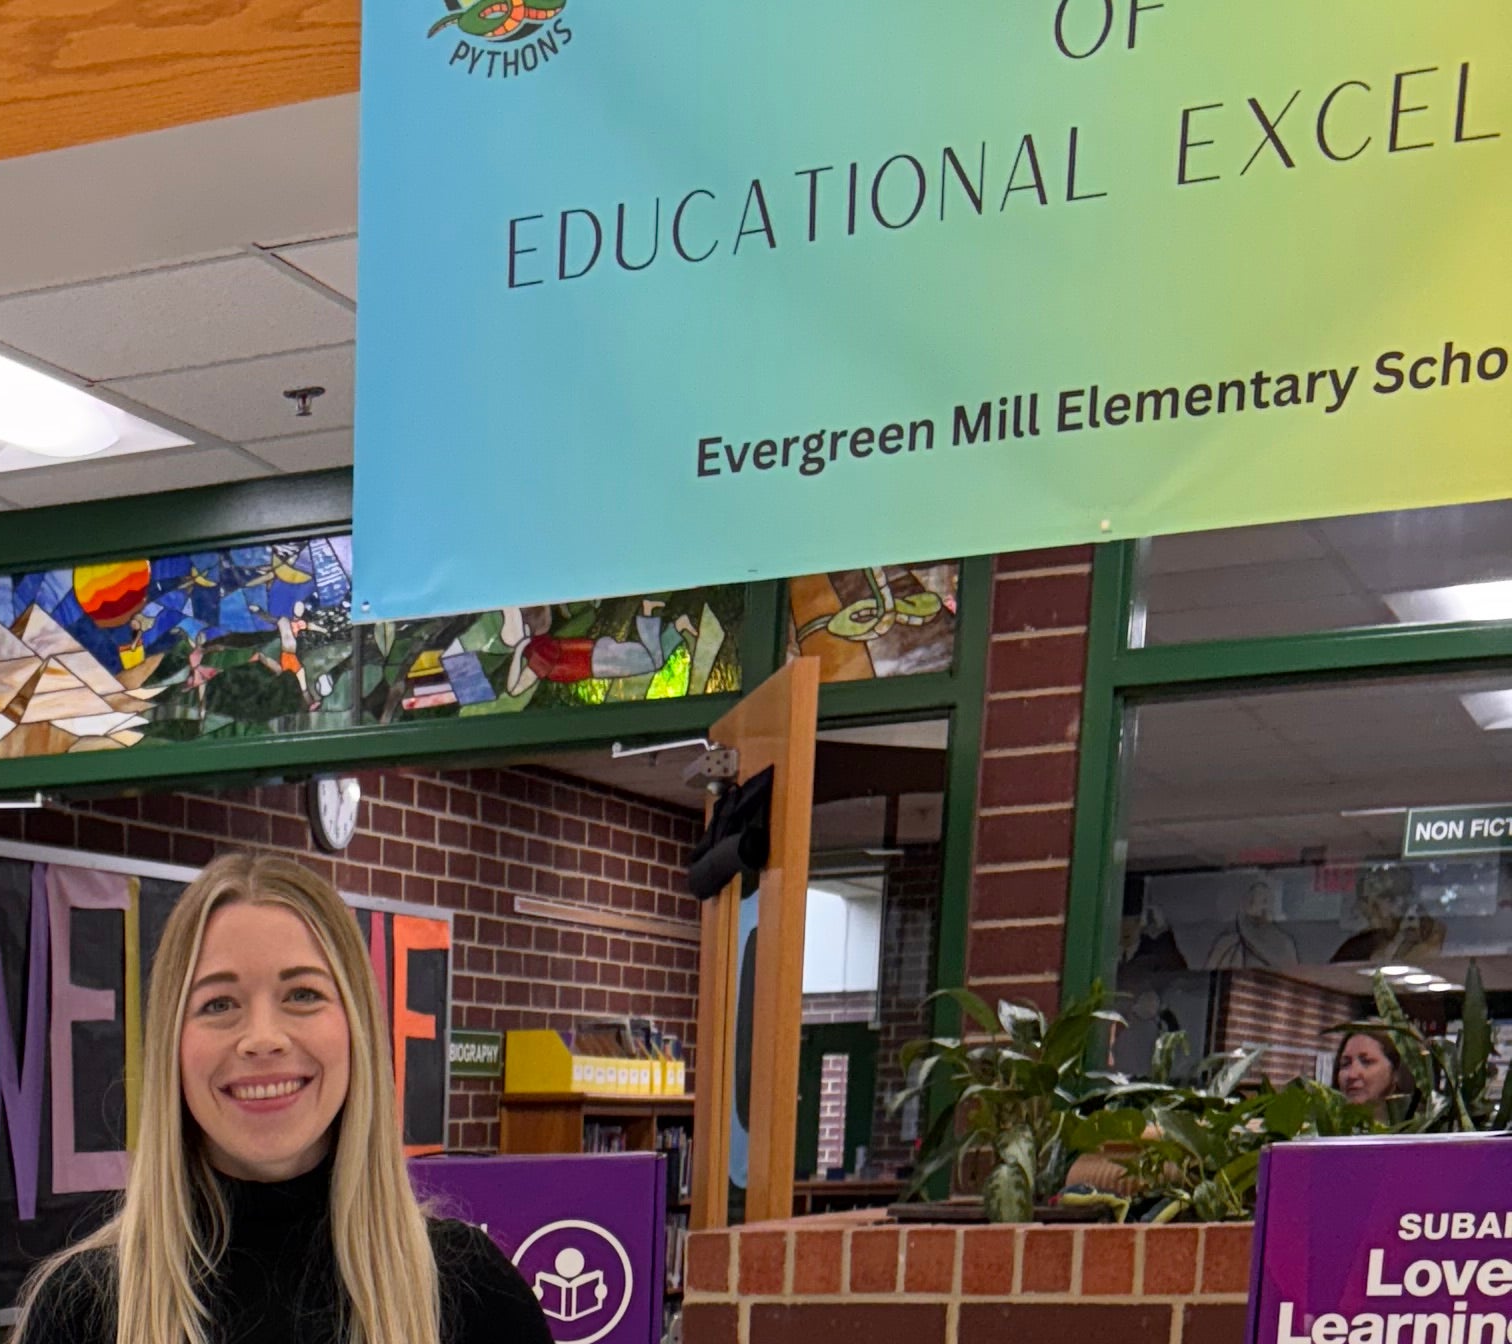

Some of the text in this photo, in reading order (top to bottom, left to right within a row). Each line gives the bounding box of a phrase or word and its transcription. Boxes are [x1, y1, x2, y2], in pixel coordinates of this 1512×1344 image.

[449, 18, 572, 78] PYTHONS
[1054, 0, 1165, 59] OF
[507, 62, 1501, 289] EDUCATIONAL EXCEL
[695, 340, 1509, 477] Evergreen Mill Elementary Scho
[1414, 816, 1512, 841] NON FICT
[449, 1043, 498, 1063] BIOGRAPHY
[1366, 1248, 1512, 1297] Love
